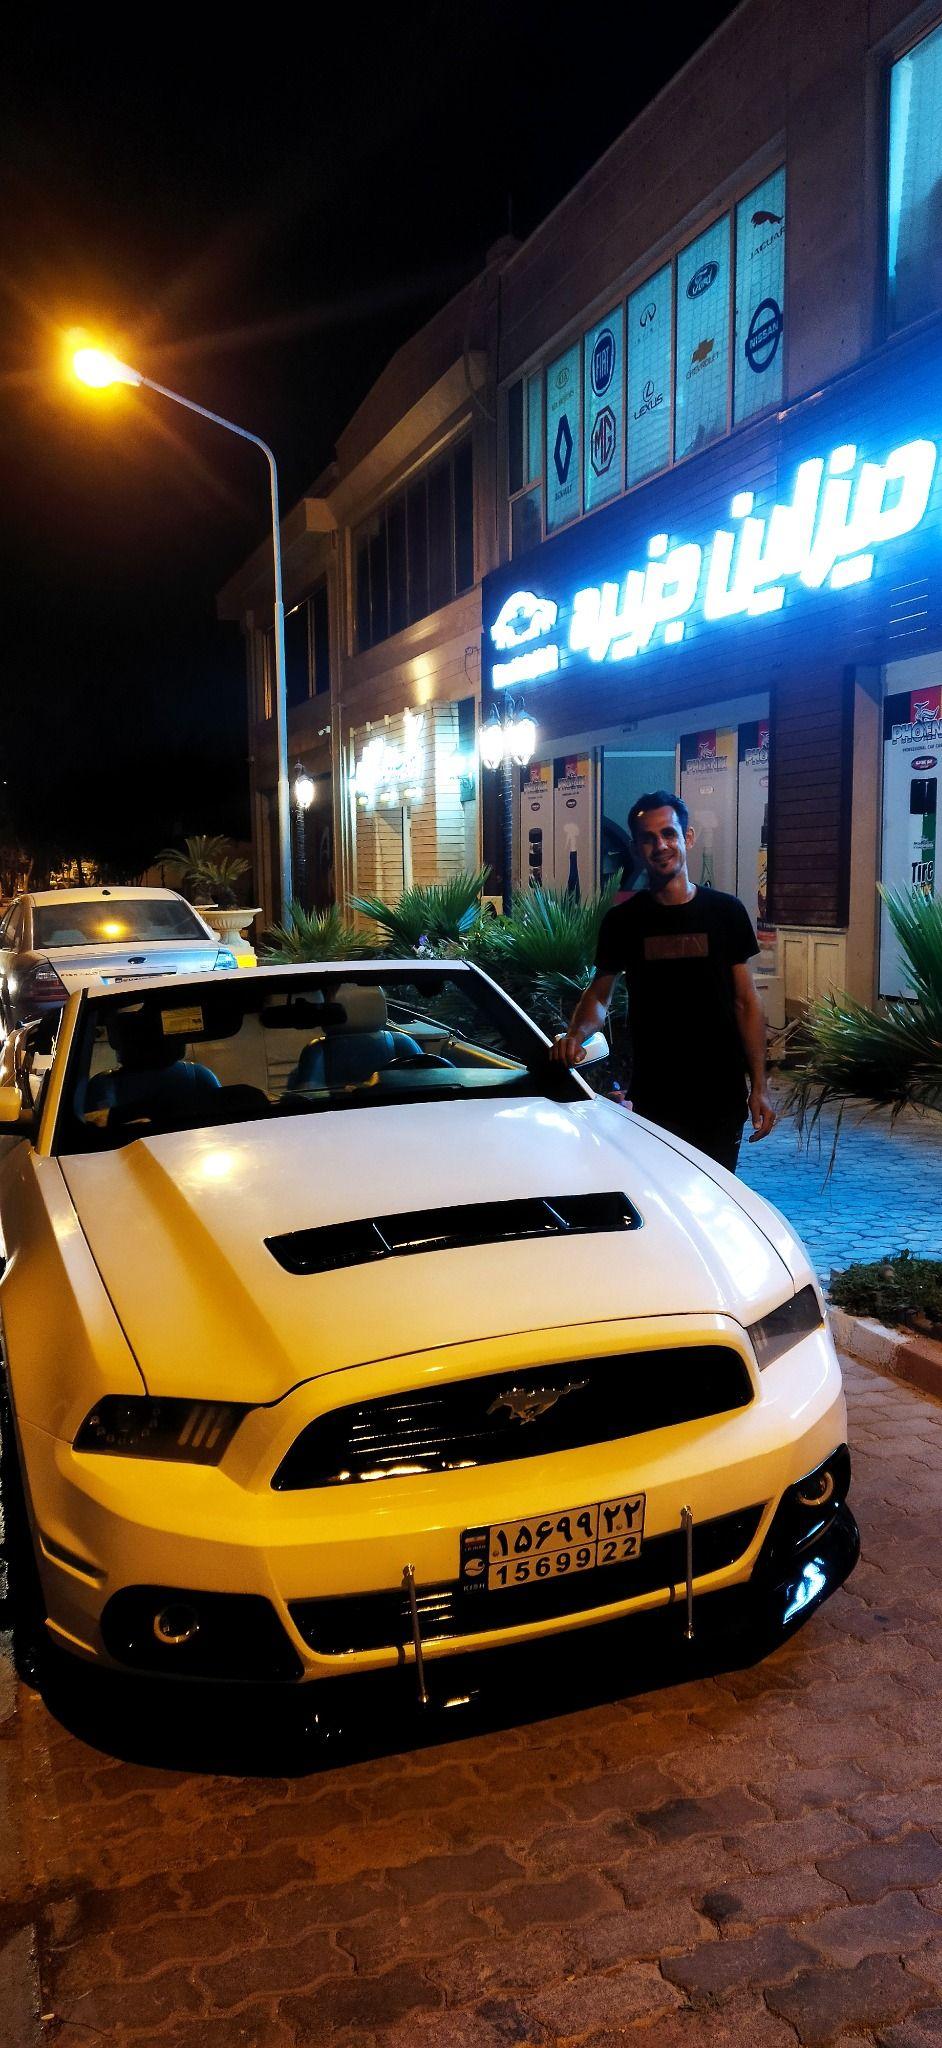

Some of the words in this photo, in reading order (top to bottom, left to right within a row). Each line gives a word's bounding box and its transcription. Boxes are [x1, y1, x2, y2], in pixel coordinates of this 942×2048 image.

[749, 319, 779, 350] NISSAN
[633, 393, 663, 420] LEXUS
[594, 414, 613, 465] MG
[911, 860, 934, 883] Tire
[496, 1511, 593, 1556] ۱۵۶۹۹
[603, 1500, 641, 1533] ۲۲
[496, 1547, 592, 1585] 15699
[602, 1536, 637, 1562] 22
